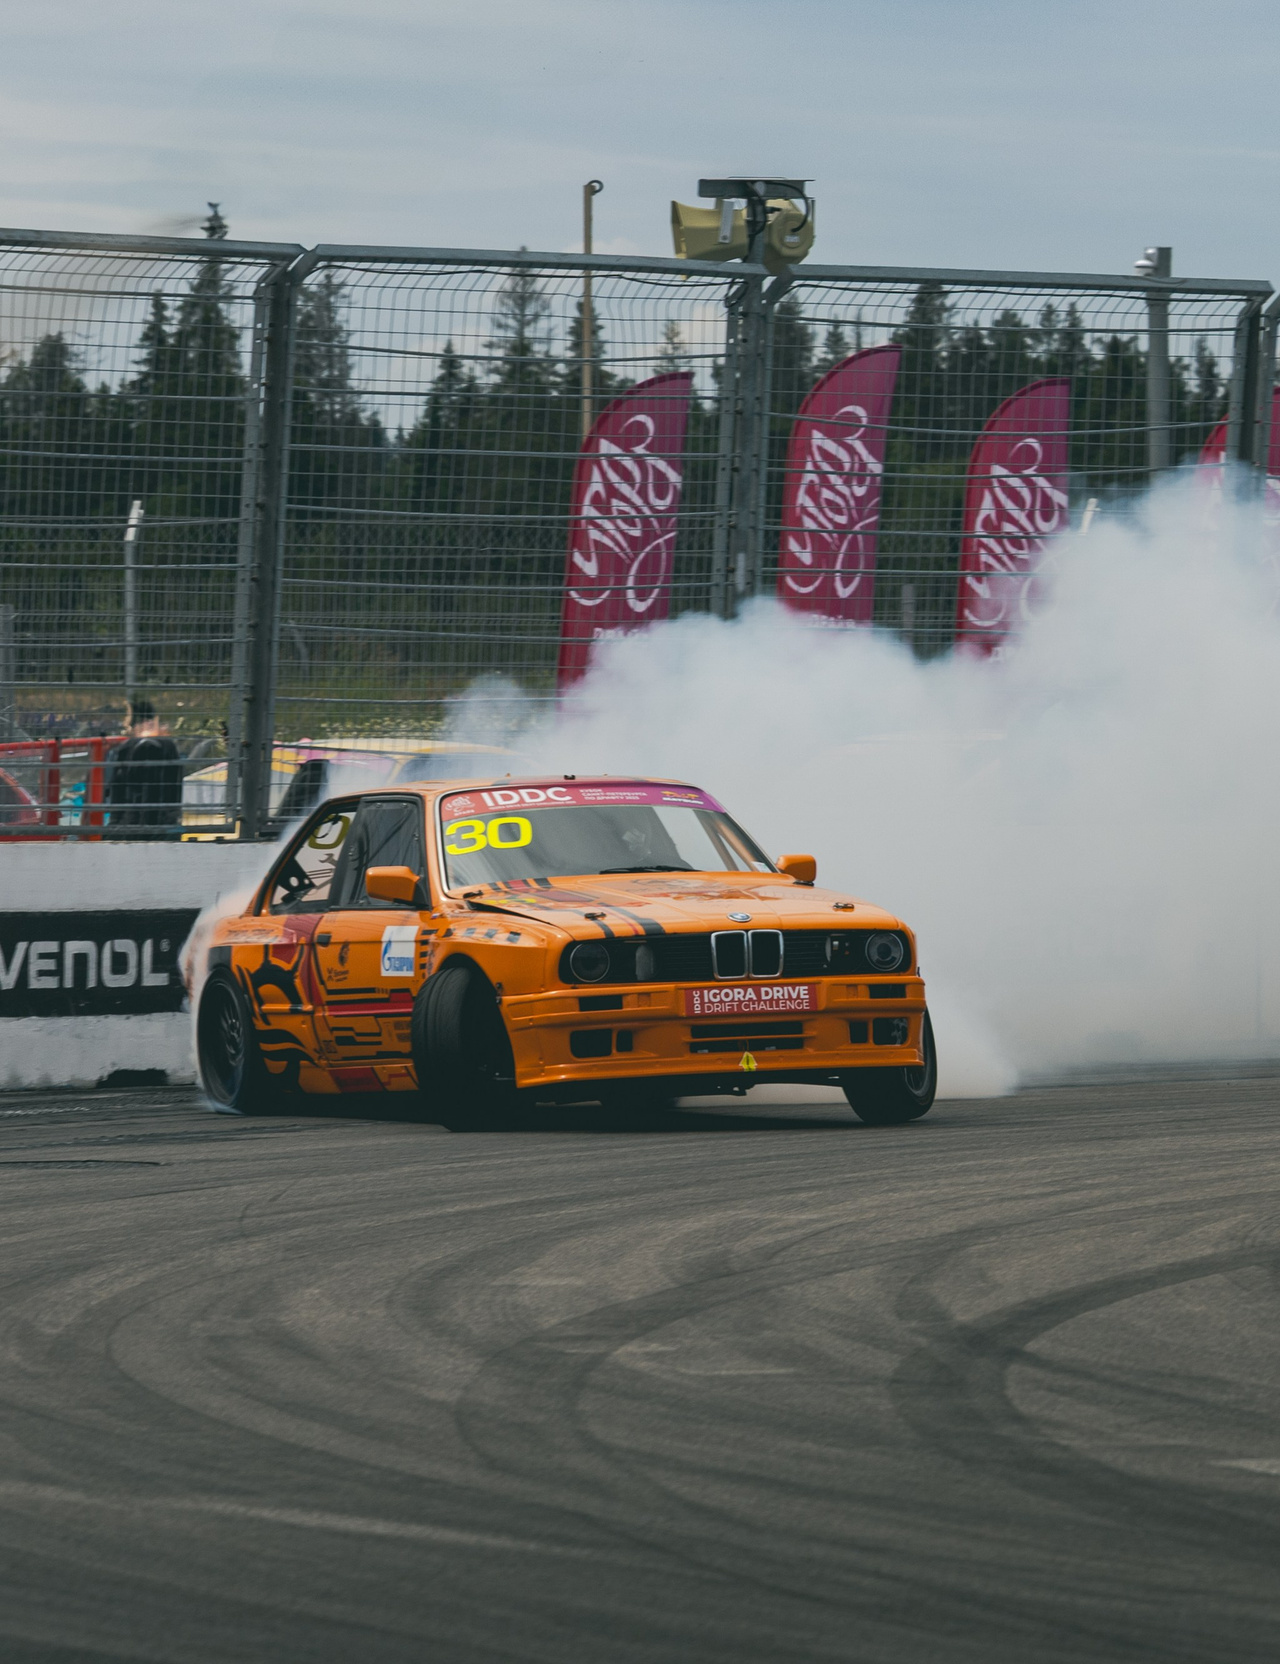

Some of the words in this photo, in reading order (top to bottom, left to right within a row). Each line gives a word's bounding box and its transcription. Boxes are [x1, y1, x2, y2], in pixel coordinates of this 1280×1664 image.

[481, 787, 573, 807] IDDC
[445, 816, 533, 855] 30
[693, 990, 702, 1014] IDDC
[703, 987, 757, 1002] IGORA
[761, 986, 810, 1000] DRIVE
[704, 1001, 739, 1013] DRIFT
[741, 999, 811, 1012] CHALLENGE
